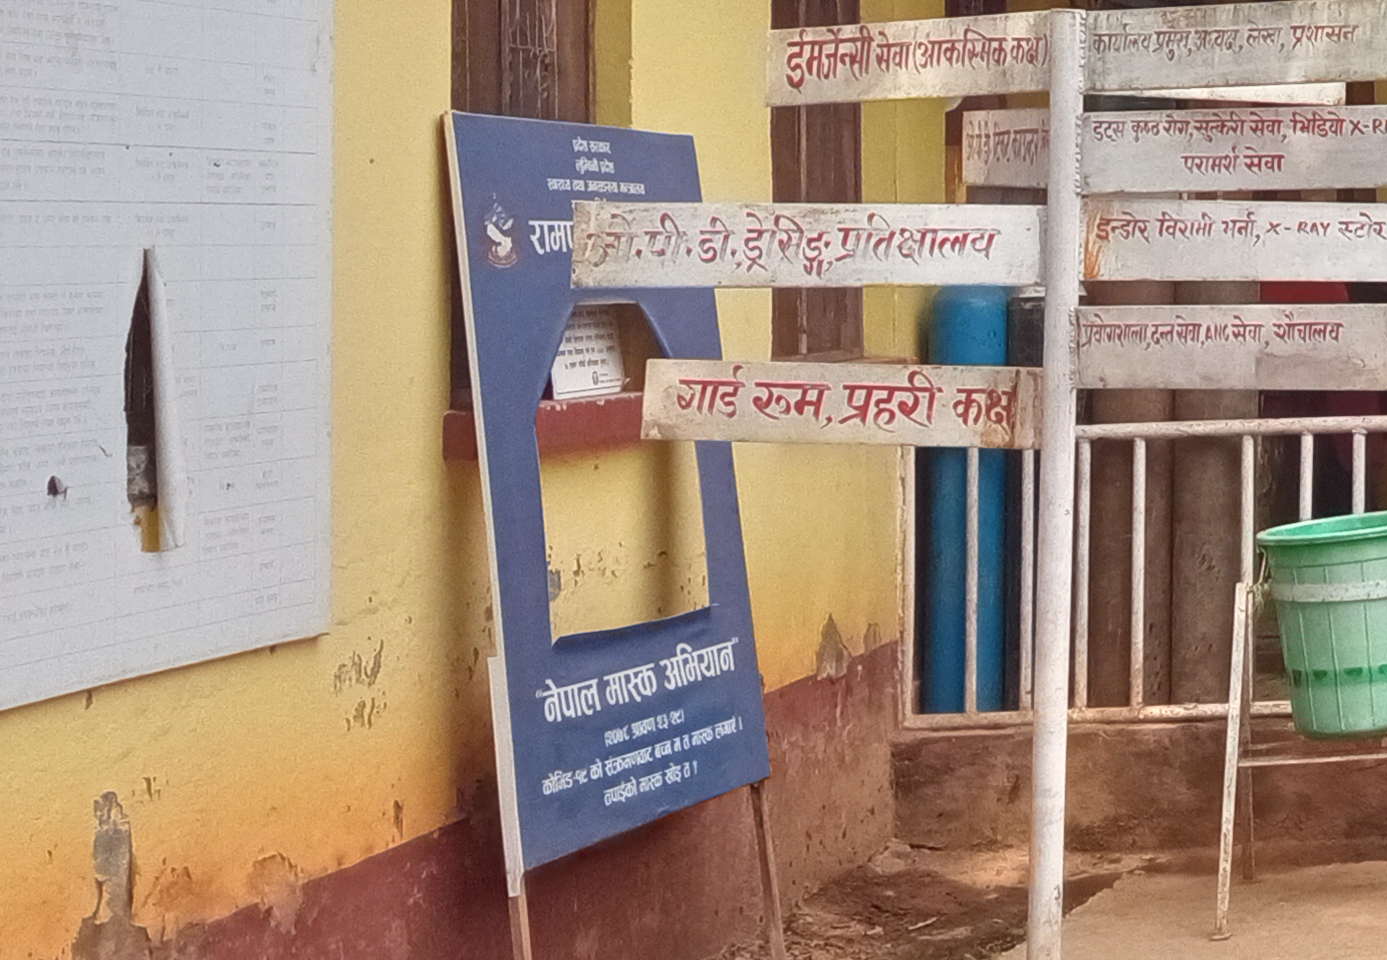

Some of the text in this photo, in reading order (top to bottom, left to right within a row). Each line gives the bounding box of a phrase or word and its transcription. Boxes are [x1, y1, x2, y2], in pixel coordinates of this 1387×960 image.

[1242, 146, 1286, 173] सेवा
[675, 363, 747, 419] गार्ड
[838, 368, 943, 433] प्रहरी
[602, 661, 658, 708] मास्क
